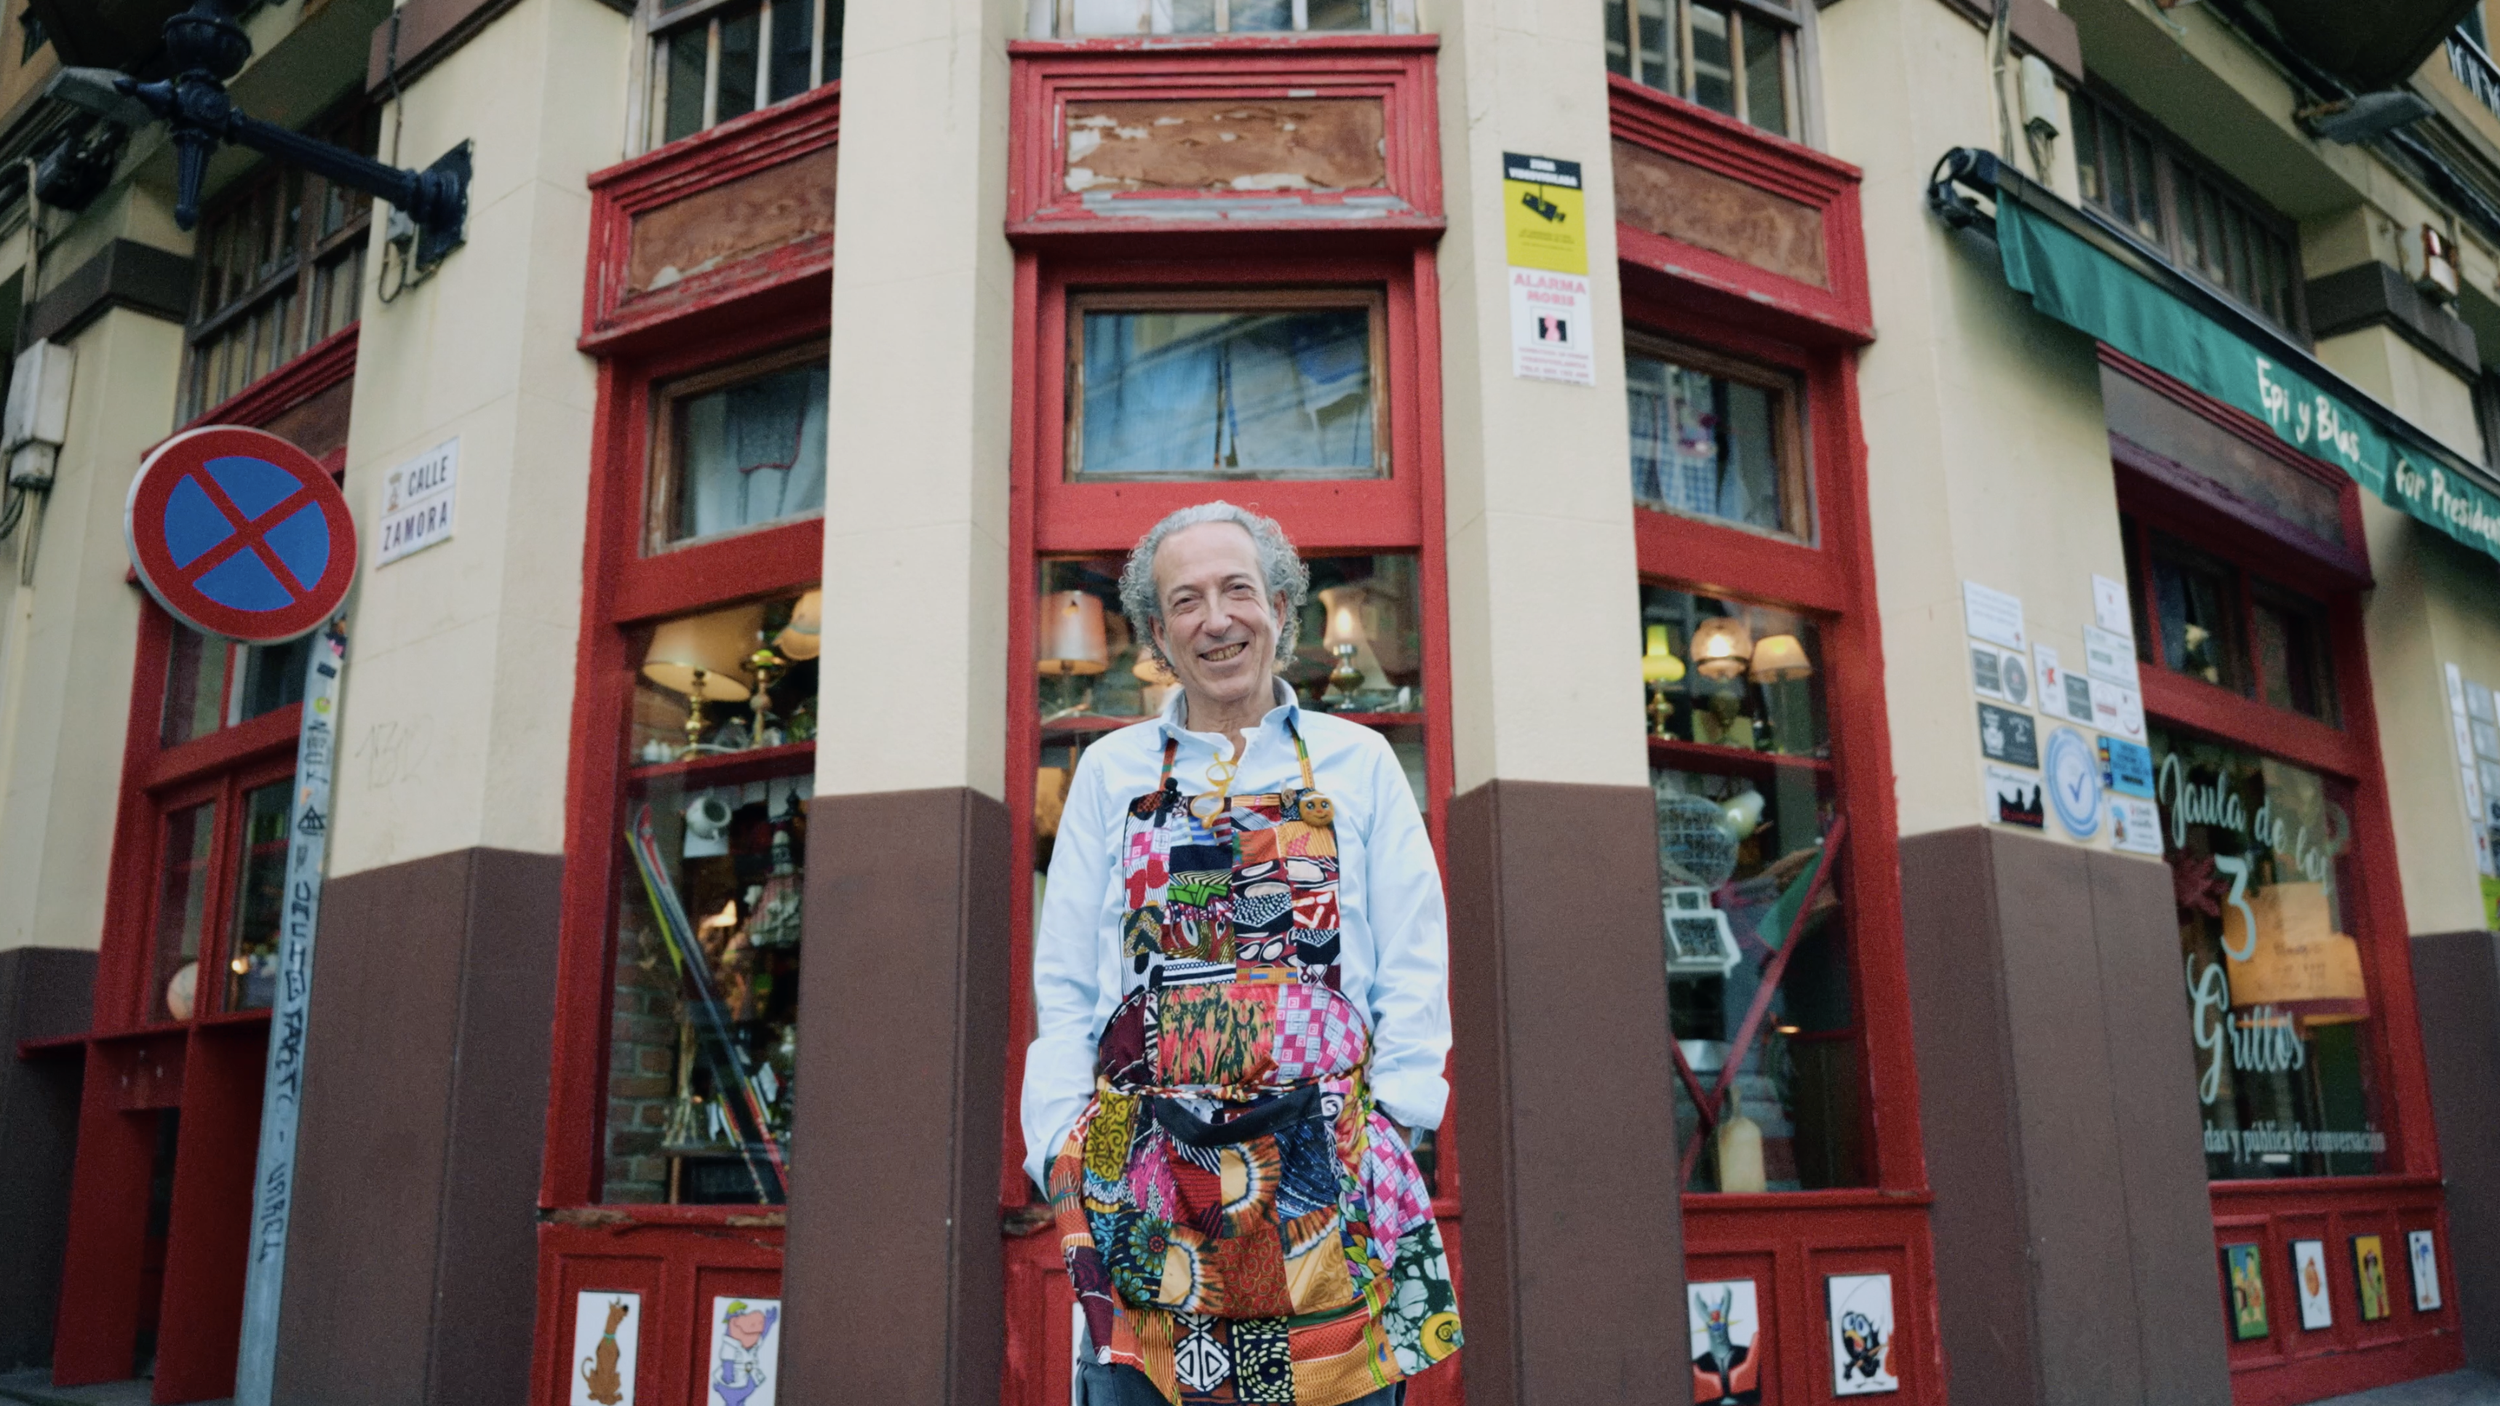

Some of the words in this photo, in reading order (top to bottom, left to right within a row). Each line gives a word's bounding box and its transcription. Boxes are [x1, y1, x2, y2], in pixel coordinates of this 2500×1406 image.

[1514, 273, 1587, 295] ALARMA
[2256, 355, 2290, 426] Epi
[2296, 402, 2311, 444] y
[2395, 458, 2426, 502] for
[408, 455, 448, 497] CALLE
[383, 501, 447, 552] ZAMORA
[2159, 752, 2247, 849] Jaula
[2254, 796, 2287, 855] de
[2214, 853, 2257, 962] 3
[2187, 953, 2305, 1105] Grillos
[2204, 1119, 2229, 1153] das
[2229, 1129, 2240, 1164] y
[2294, 1121, 2310, 1153] de
